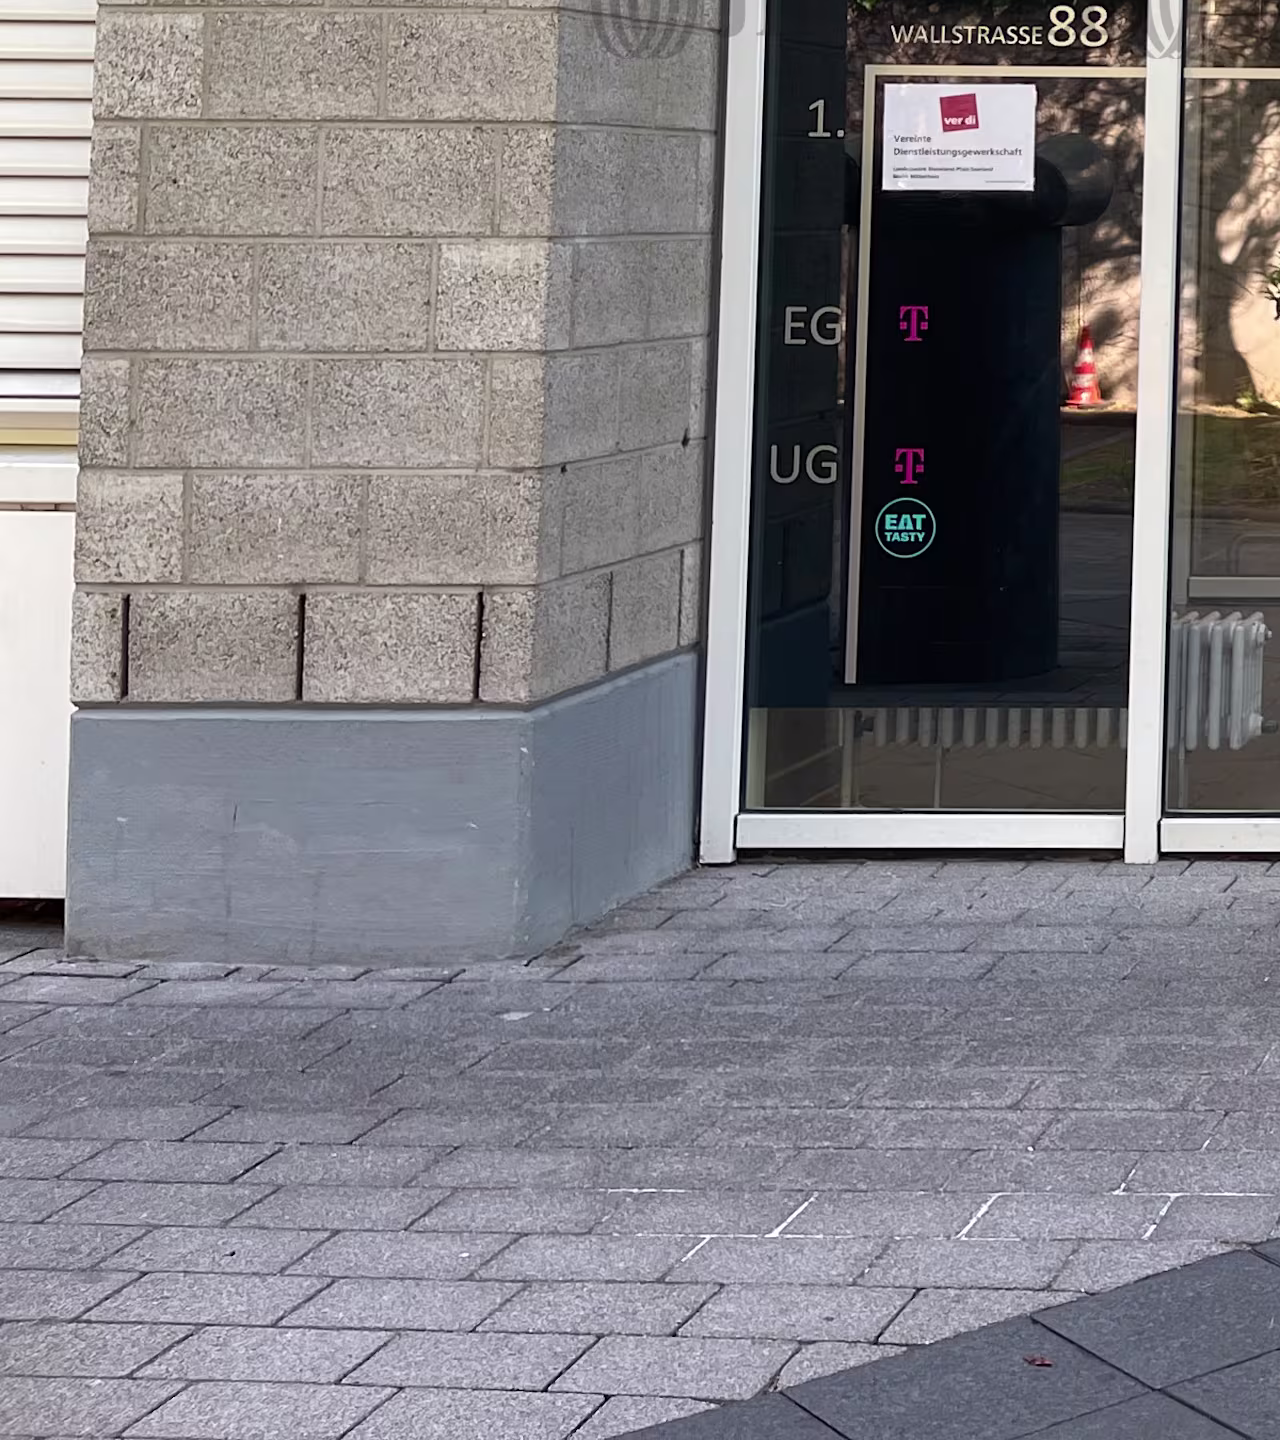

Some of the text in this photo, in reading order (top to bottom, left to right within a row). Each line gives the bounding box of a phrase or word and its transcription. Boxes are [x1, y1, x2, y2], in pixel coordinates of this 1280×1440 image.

[890, 4, 1109, 47] WALLSTRASSE 88
[807, 98, 846, 138] 1.
[893, 134, 932, 143] Vereinte
[893, 147, 1023, 158] Dienstleistungsgewerkschaft
[783, 305, 842, 346] EG
[769, 444, 838, 485] UG
[884, 513, 927, 531] EAT
[884, 531, 926, 542] TASTY
